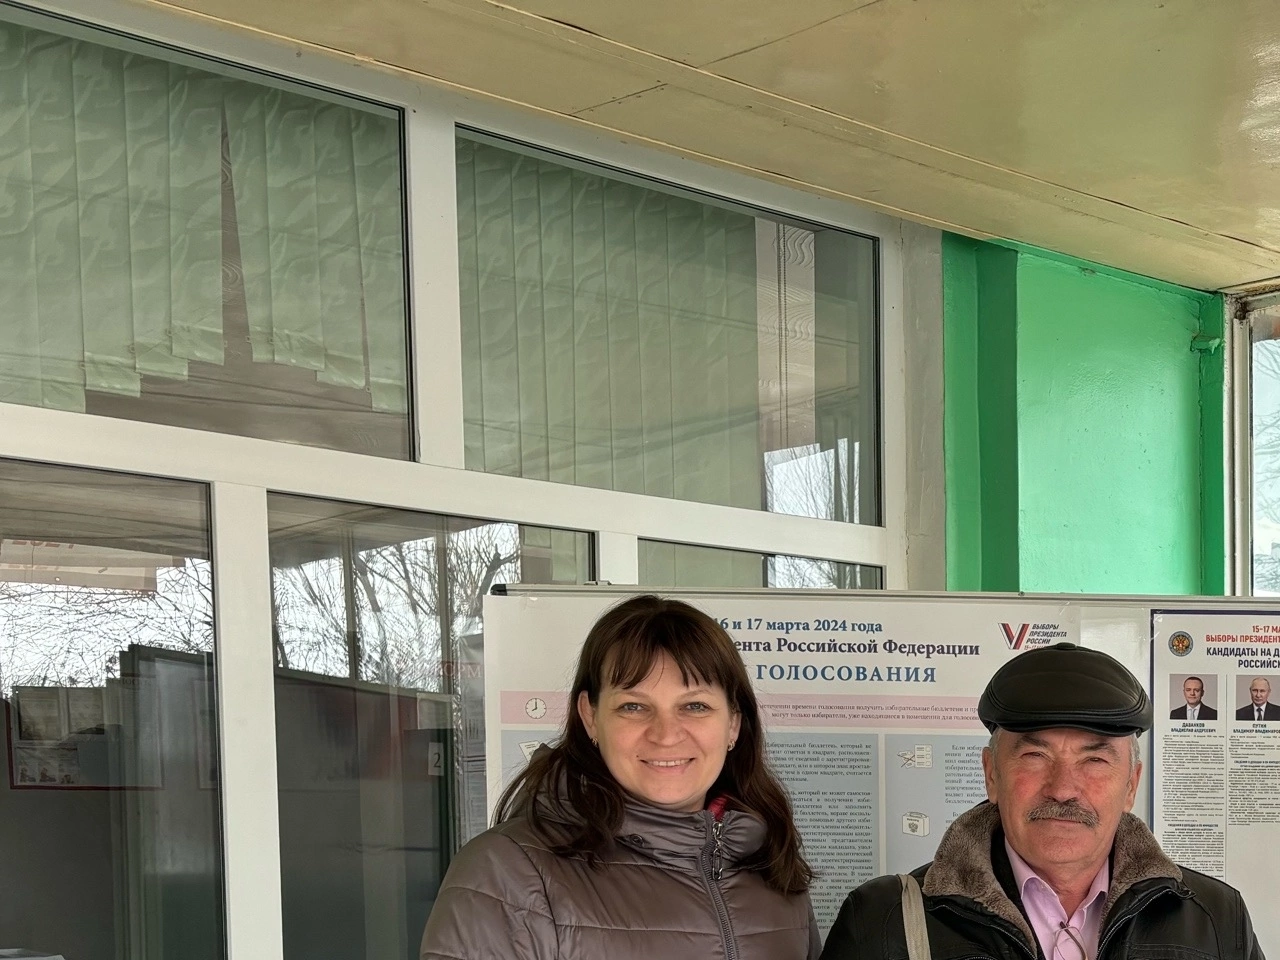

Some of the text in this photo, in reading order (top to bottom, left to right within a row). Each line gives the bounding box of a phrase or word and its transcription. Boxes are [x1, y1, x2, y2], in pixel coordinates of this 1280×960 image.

[732, 621, 741, 630] и
[747, 618, 762, 630] 17
[766, 621, 810, 634] марта
[813, 619, 847, 632] 2024
[850, 621, 883, 634] года
[1252, 625, 1269, 633] 15-17
[1205, 634, 1238, 643] ВЫБОРЫ
[776, 638, 878, 653] Российской
[883, 639, 980, 659] Федерации
[1206, 647, 1258, 657] КАНДИДАТЫ
[1261, 647, 1271, 656] НА
[756, 664, 936, 683] ГОЛОСОВАНИЯ
[433, 752, 441, 768] 2
